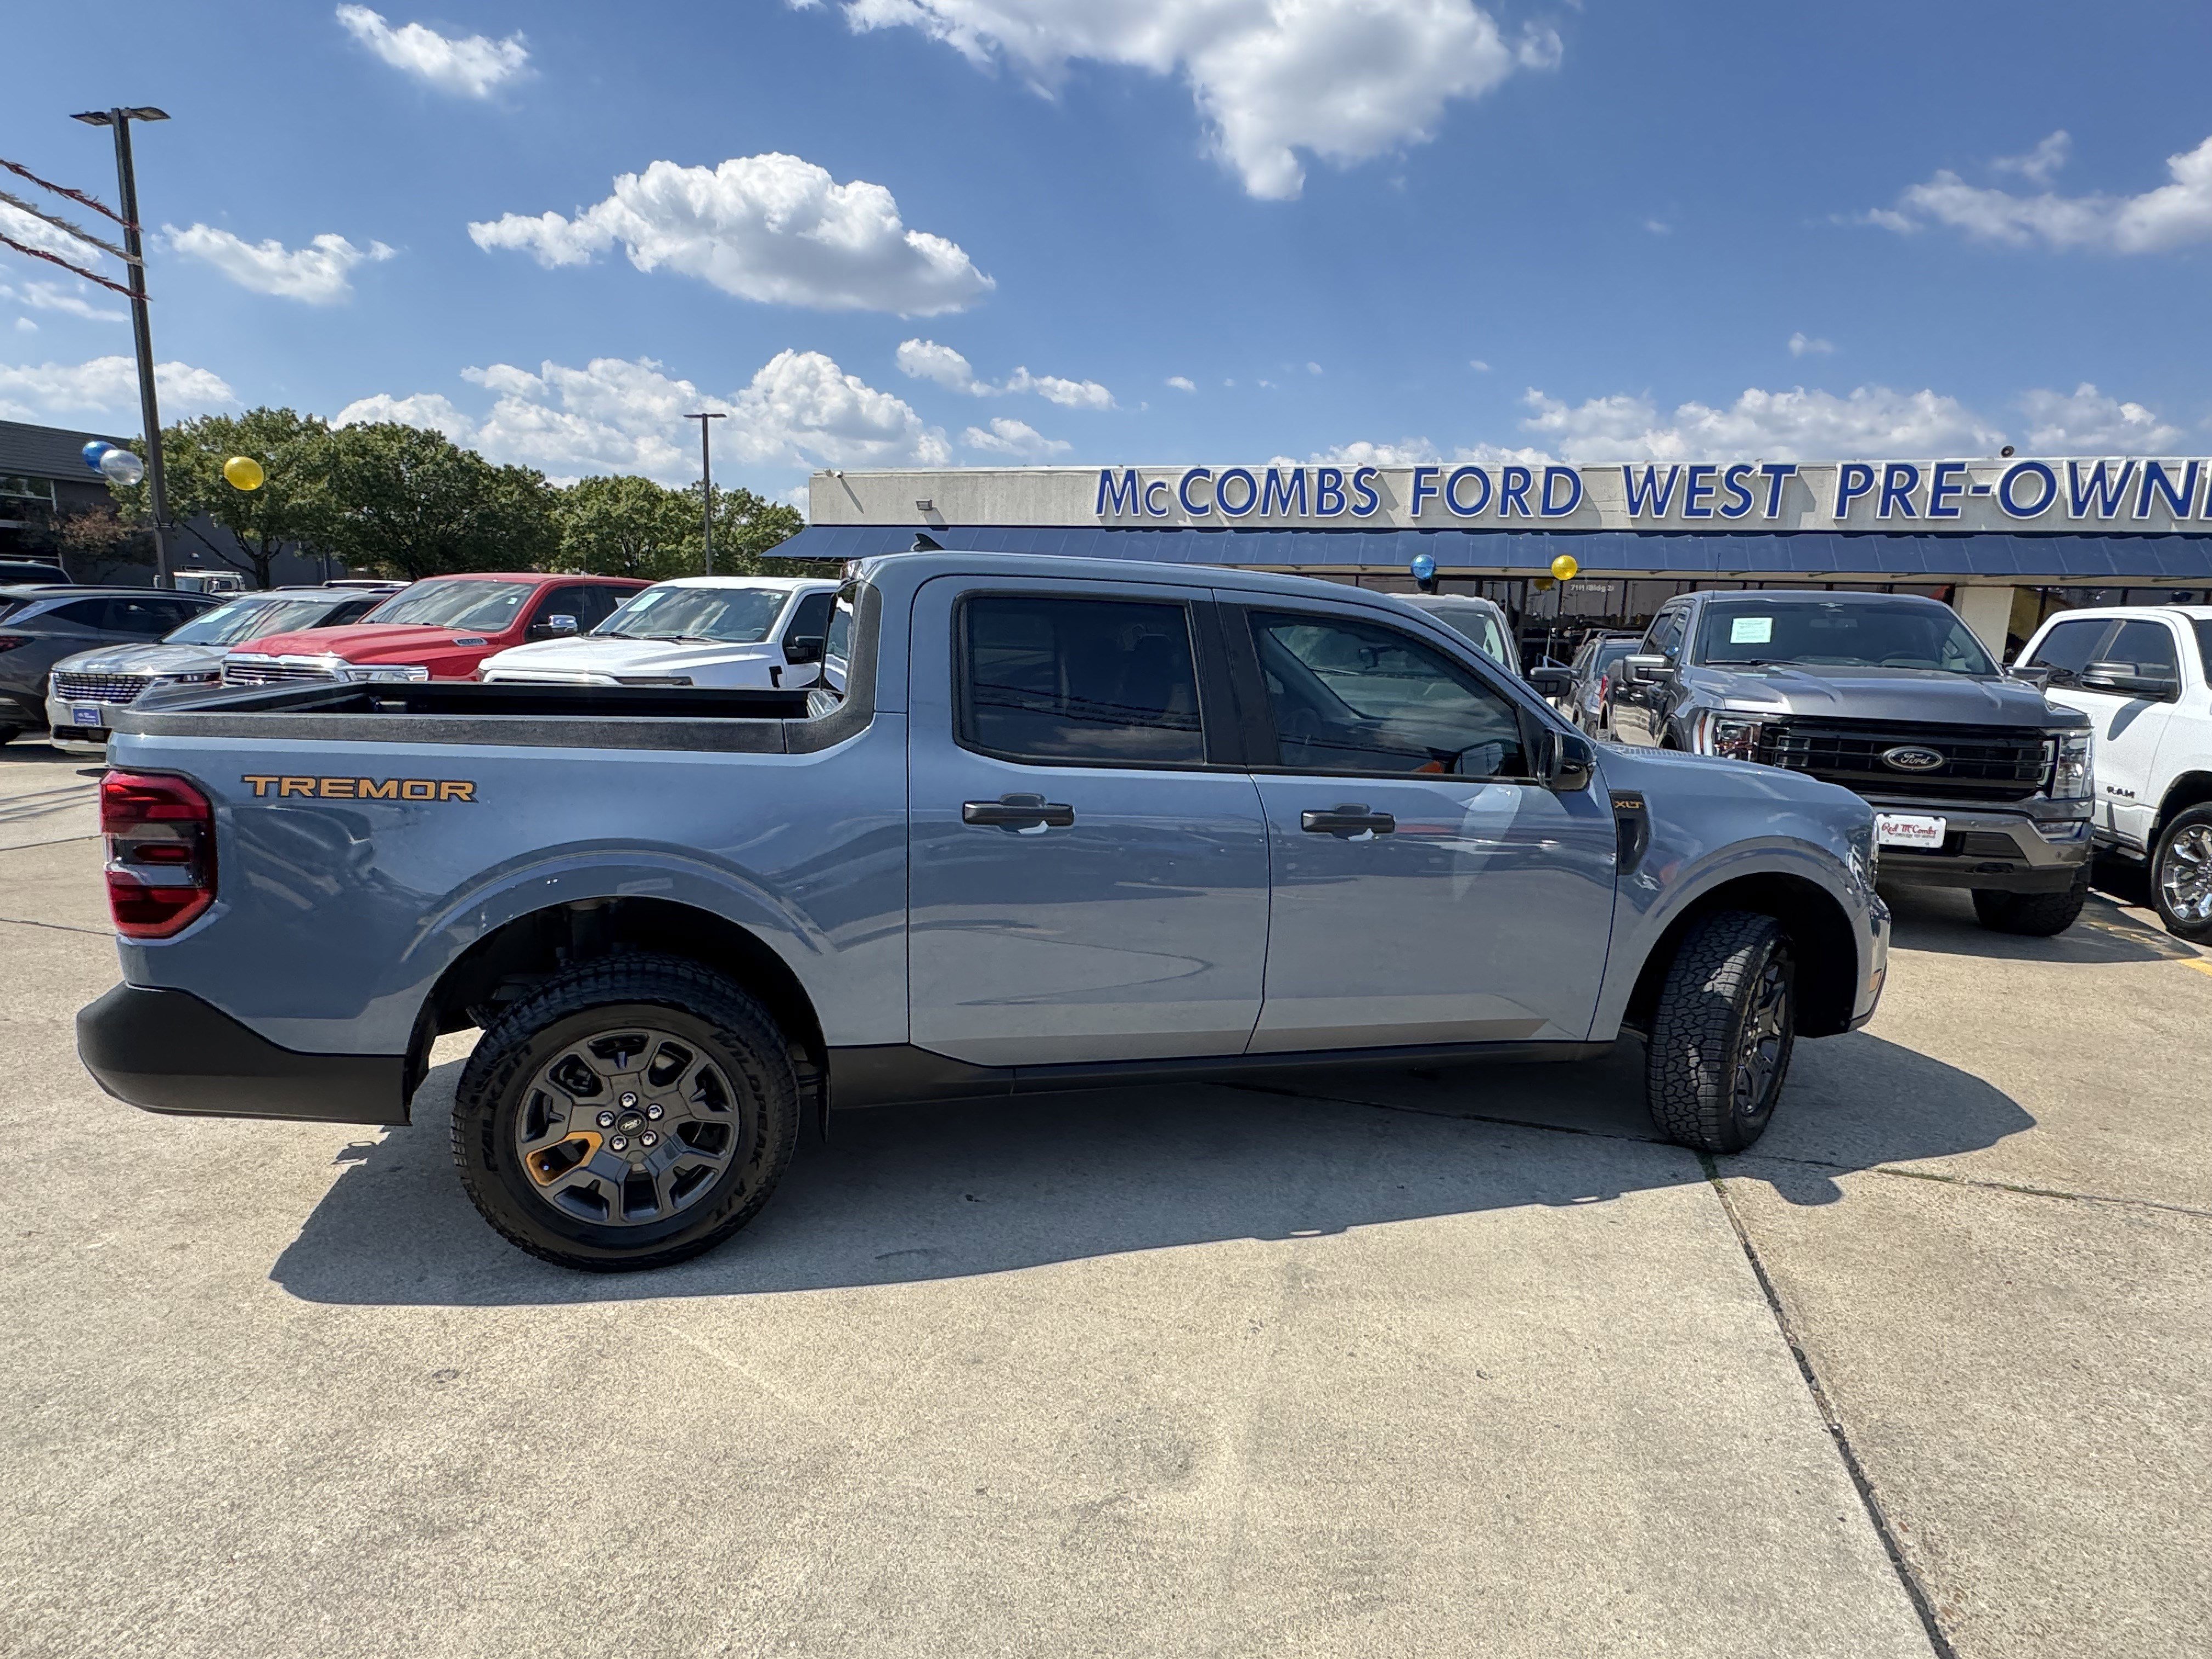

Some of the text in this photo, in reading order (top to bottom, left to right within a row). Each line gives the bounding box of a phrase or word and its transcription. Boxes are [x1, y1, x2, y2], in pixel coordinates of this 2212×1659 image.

[1096, 461, 2212, 520] McCOMBS FORD WEST PRE-OWN
[1900, 753, 1931, 764] Ford
[241, 775, 478, 803] TREMOR
[2107, 786, 2135, 798] RAM
[1882, 822, 1899, 834] Red
[712, 1030, 768, 1171] WILDPEAK
